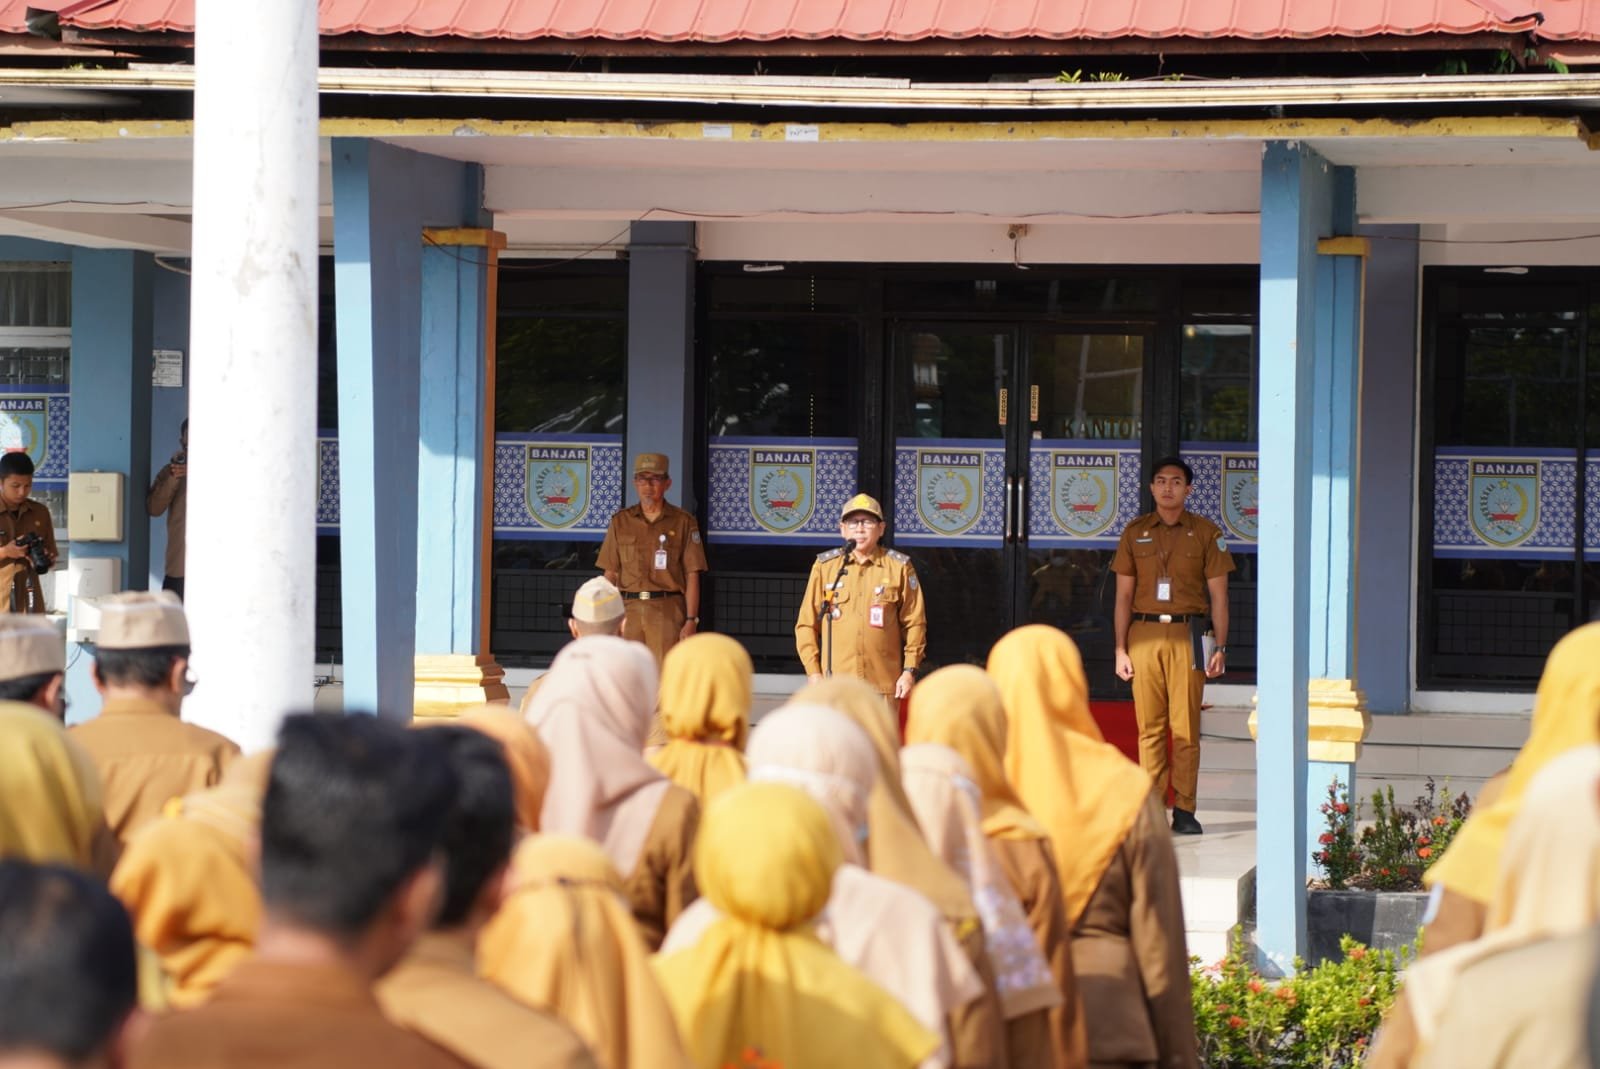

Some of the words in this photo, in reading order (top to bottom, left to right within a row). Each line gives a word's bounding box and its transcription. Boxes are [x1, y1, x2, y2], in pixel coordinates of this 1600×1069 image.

[0, 400, 43, 410] ANJAR
[531, 449, 586, 459] BANJAR
[755, 453, 810, 463] BANJAR
[923, 454, 978, 465] BANJAR
[1057, 455, 1113, 466] BANJAR
[1228, 459, 1257, 469] BAN
[1475, 463, 1535, 474] BANJAR
